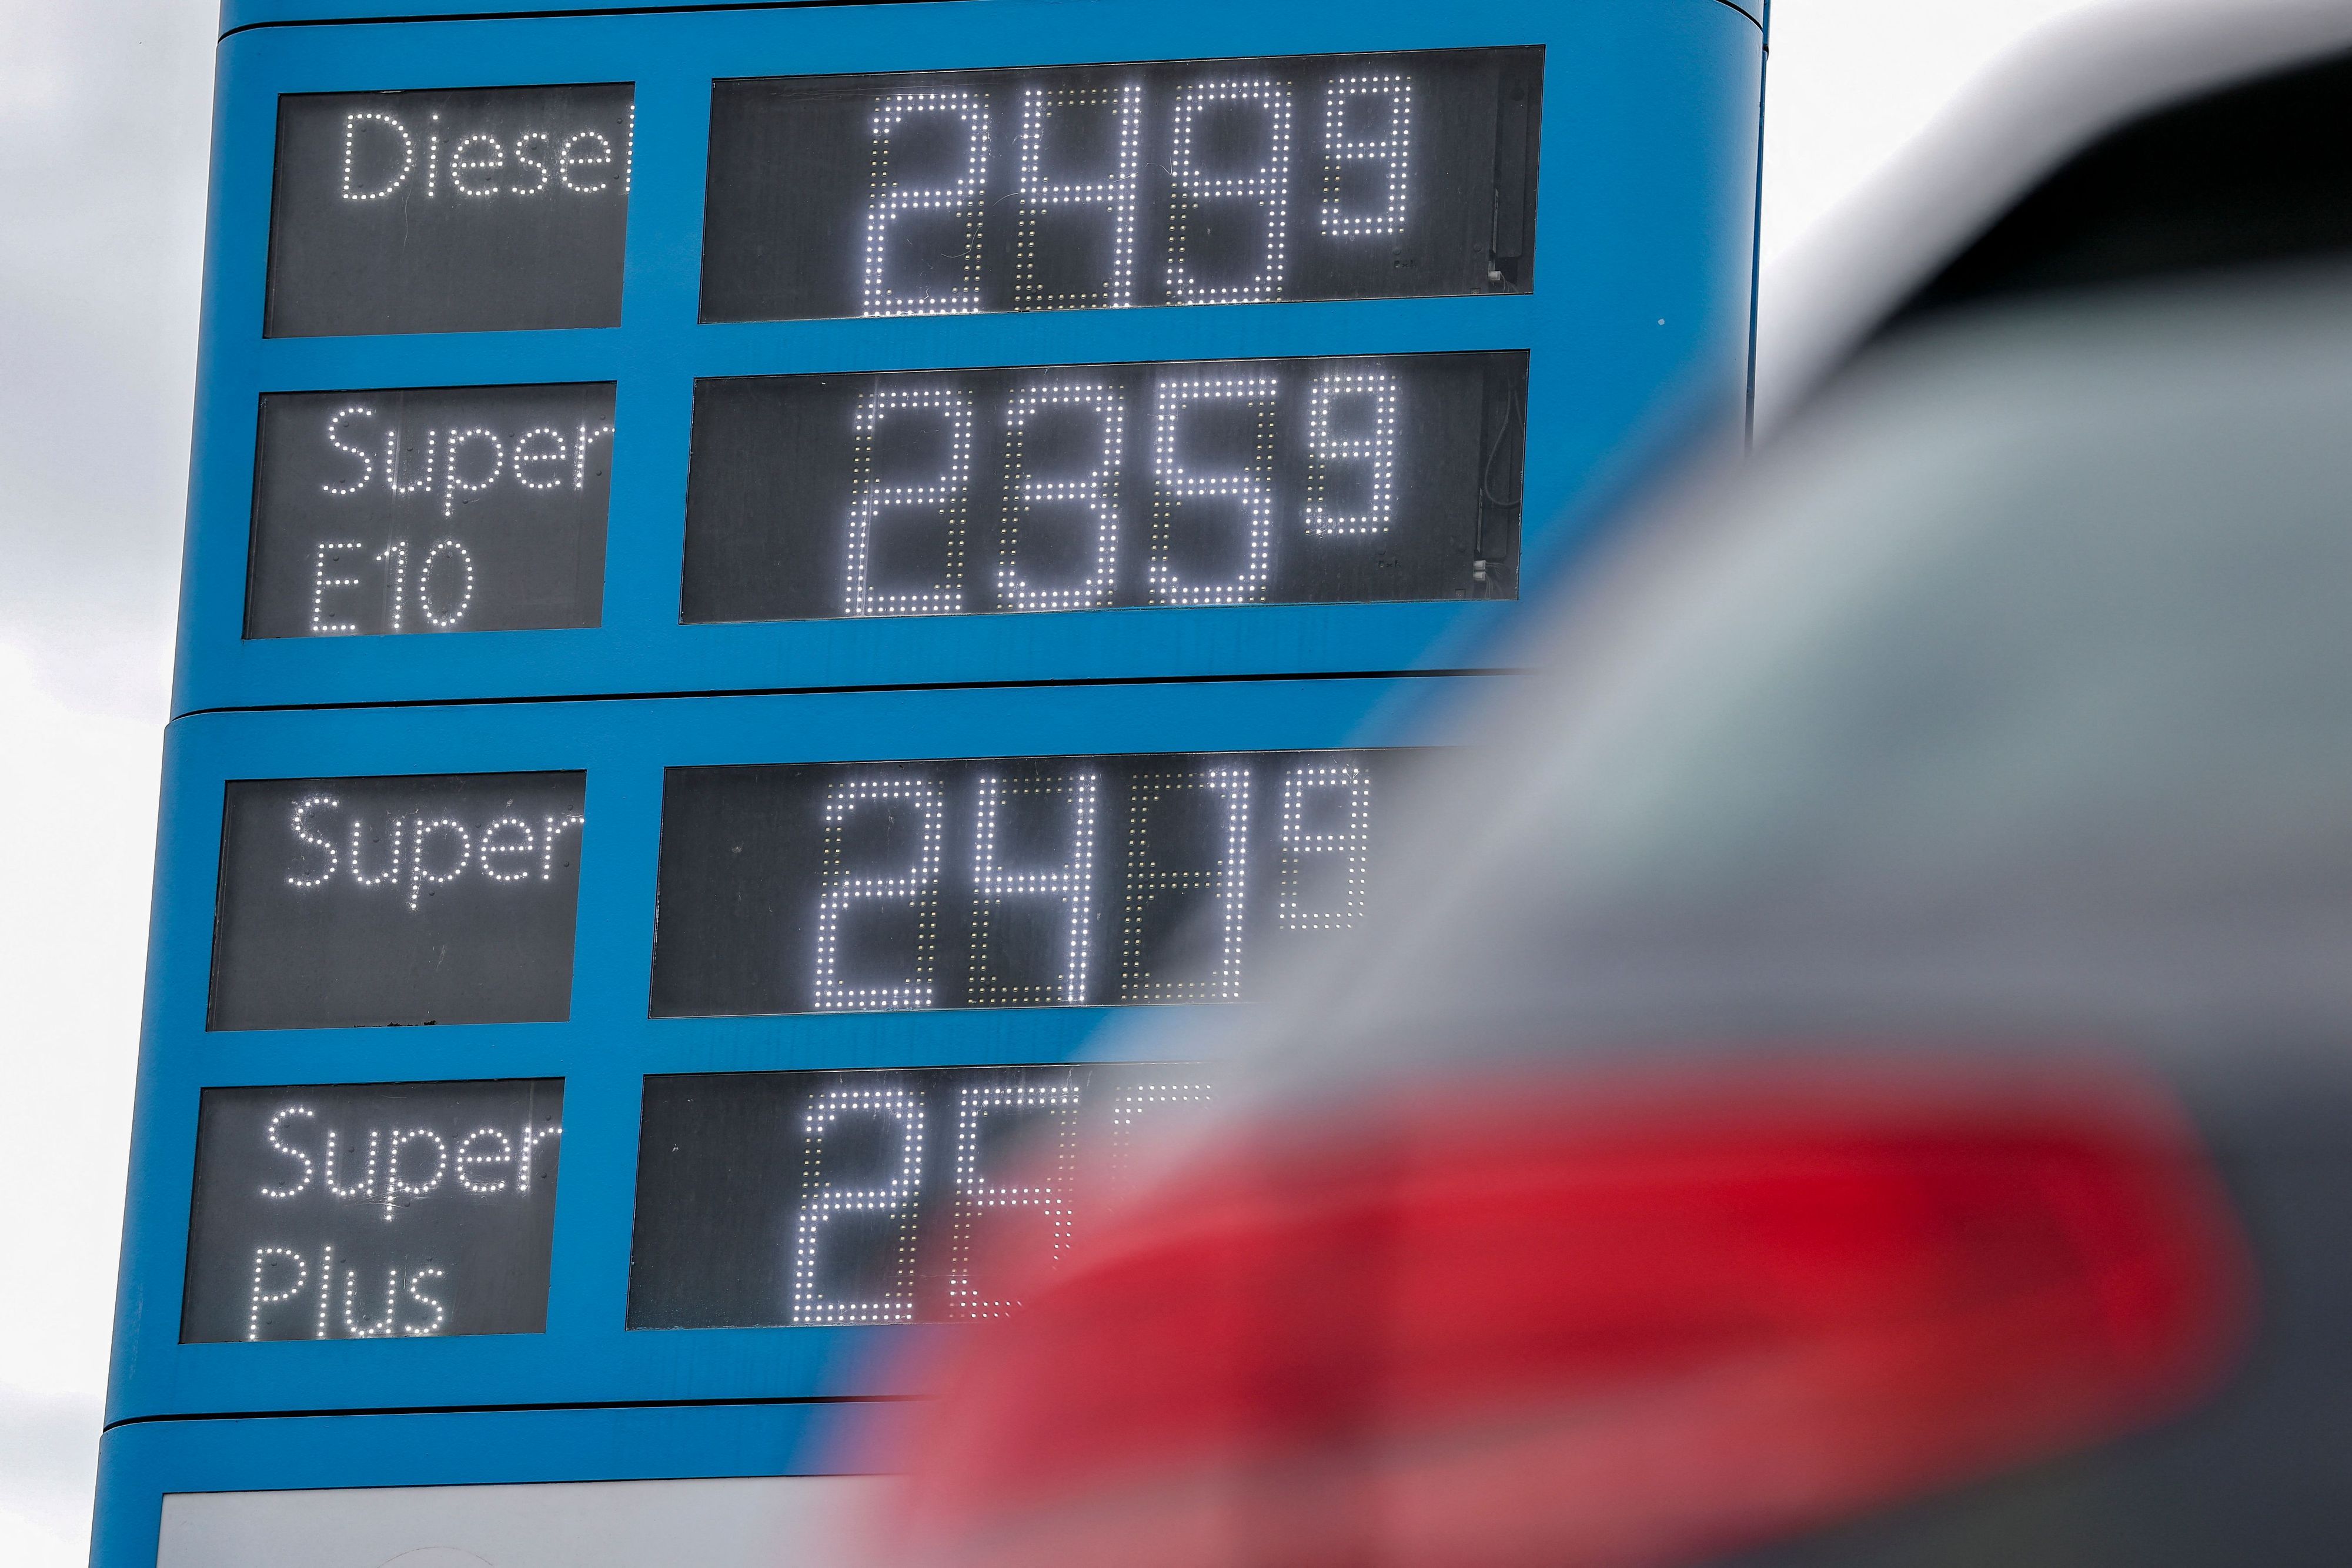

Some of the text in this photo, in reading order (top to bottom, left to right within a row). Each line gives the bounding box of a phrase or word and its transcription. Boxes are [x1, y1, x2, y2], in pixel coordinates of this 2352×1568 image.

[343, 105, 636, 200] Diesel
[323, 407, 615, 517] Super
[313, 540, 473, 631] E10
[288, 798, 585, 909] Super
[262, 1108, 563, 1221] Super
[249, 1246, 443, 1340] Plus
